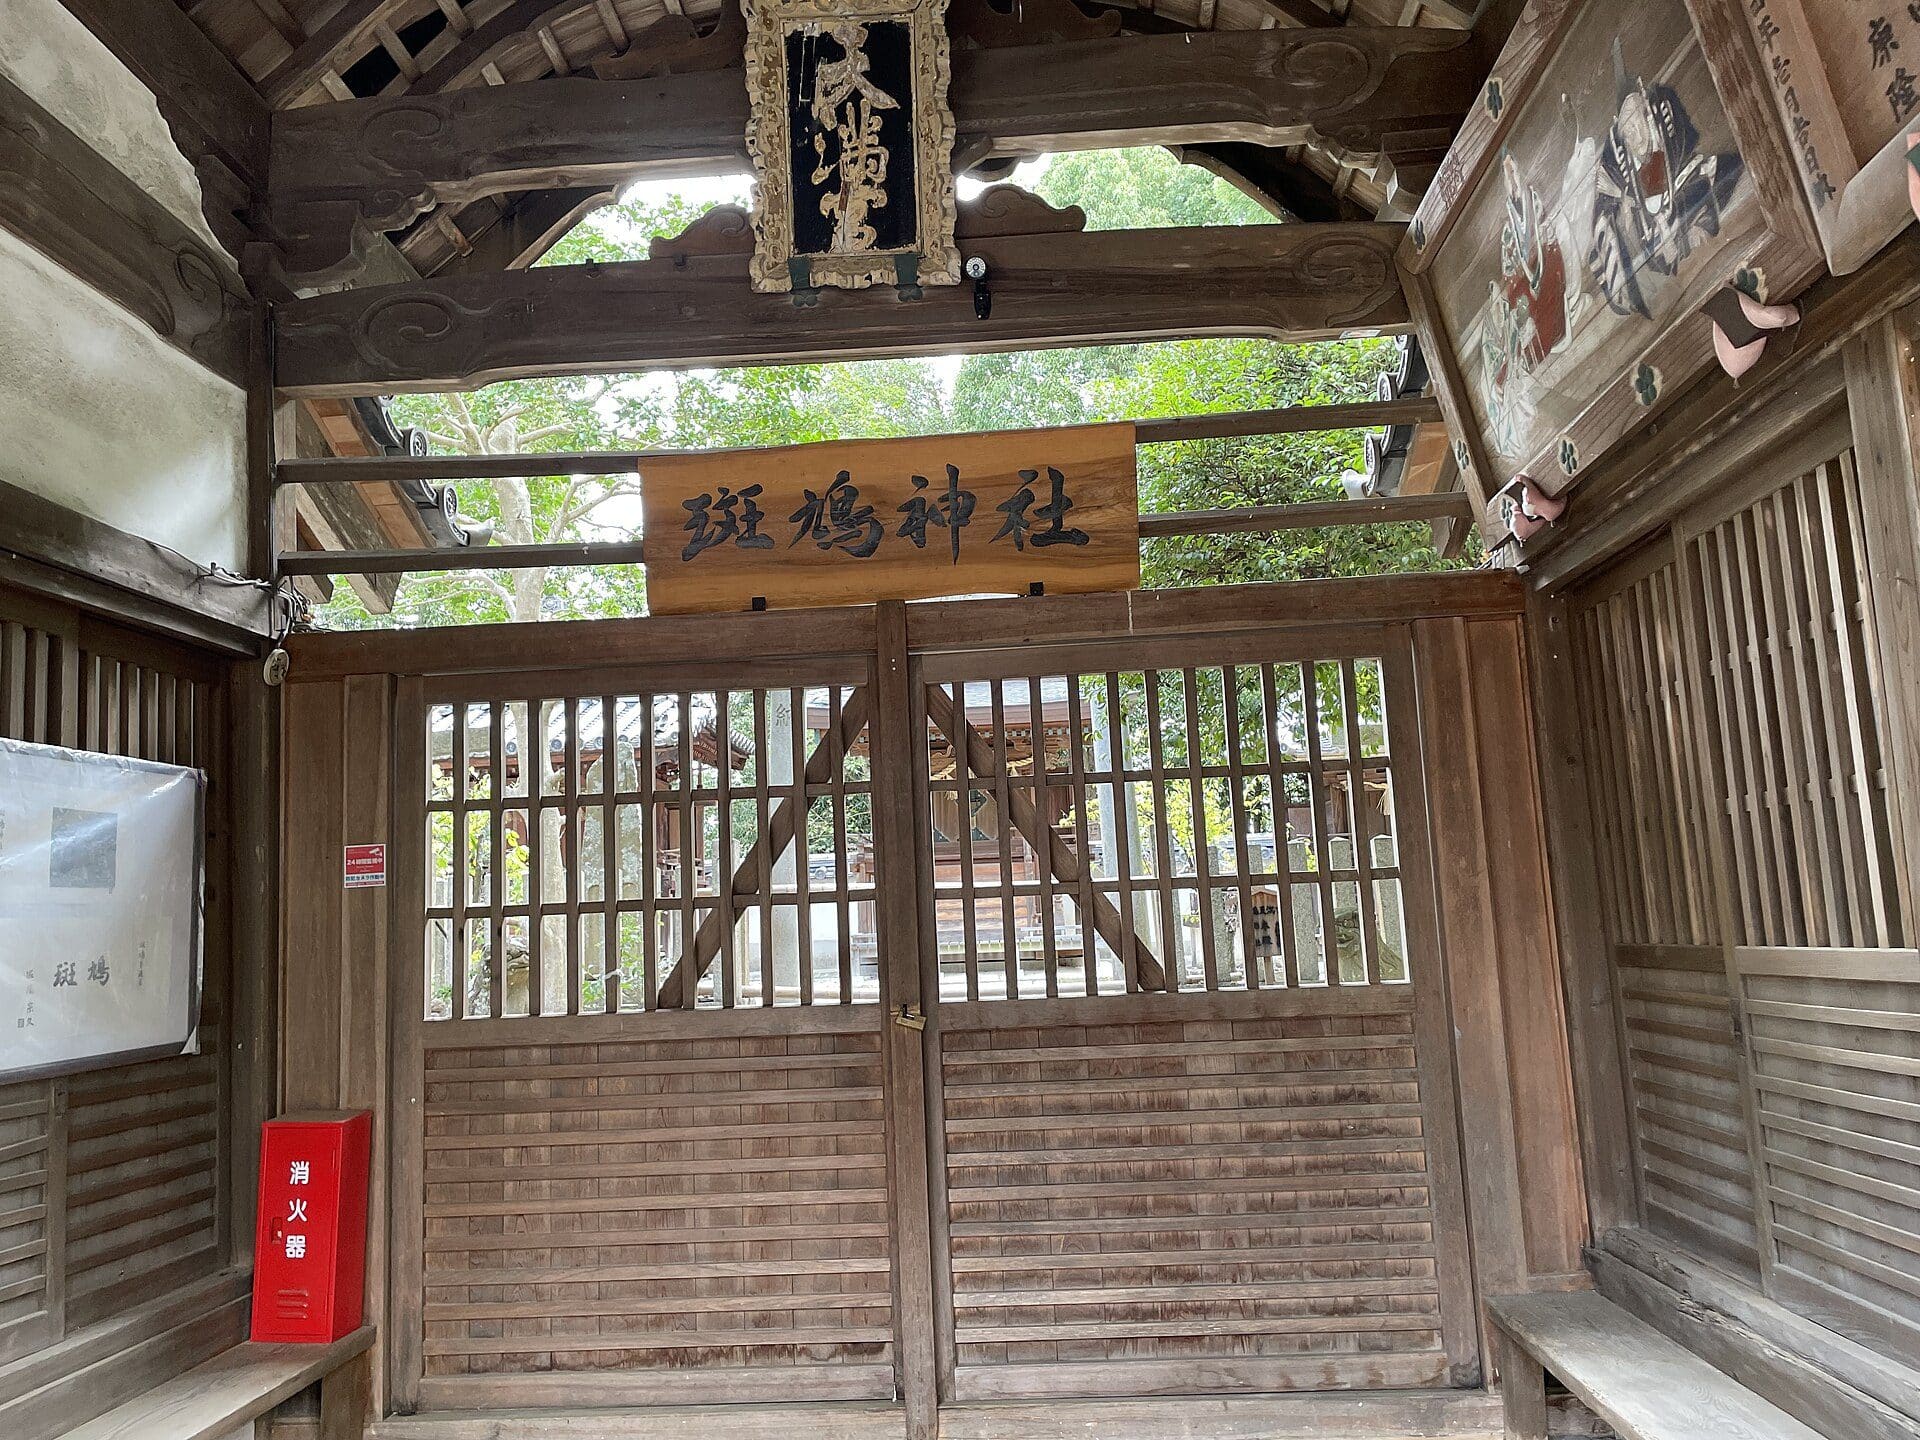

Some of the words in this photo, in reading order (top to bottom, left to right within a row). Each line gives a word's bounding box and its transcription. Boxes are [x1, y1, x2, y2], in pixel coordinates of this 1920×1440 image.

[681, 463, 1090, 566] 斑鳩神社
[285, 1160, 310, 1259] 消火器
